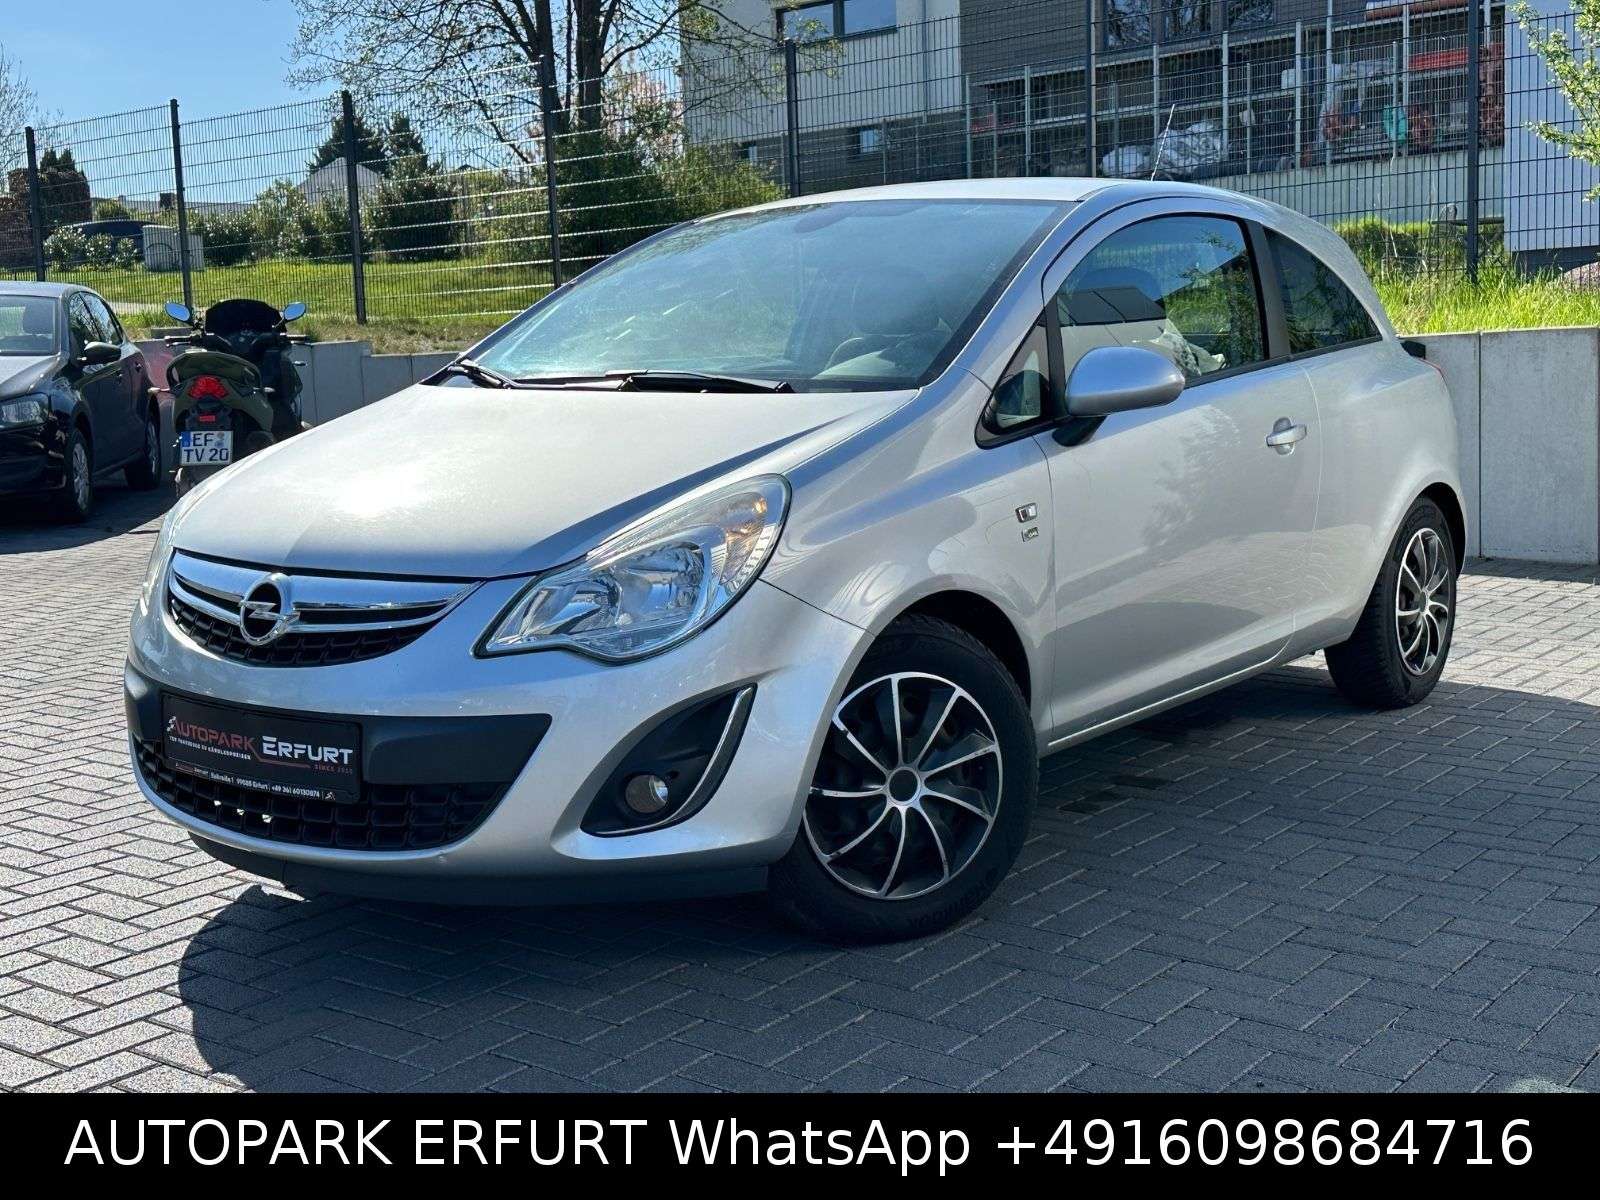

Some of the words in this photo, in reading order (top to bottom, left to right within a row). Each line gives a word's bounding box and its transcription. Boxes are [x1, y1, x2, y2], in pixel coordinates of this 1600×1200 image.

[192, 432, 215, 447] EF
[183, 448, 205, 462] TV
[208, 448, 230, 462] 20
[167, 716, 255, 751] AUTOPARK
[262, 735, 354, 765] ERFURT
